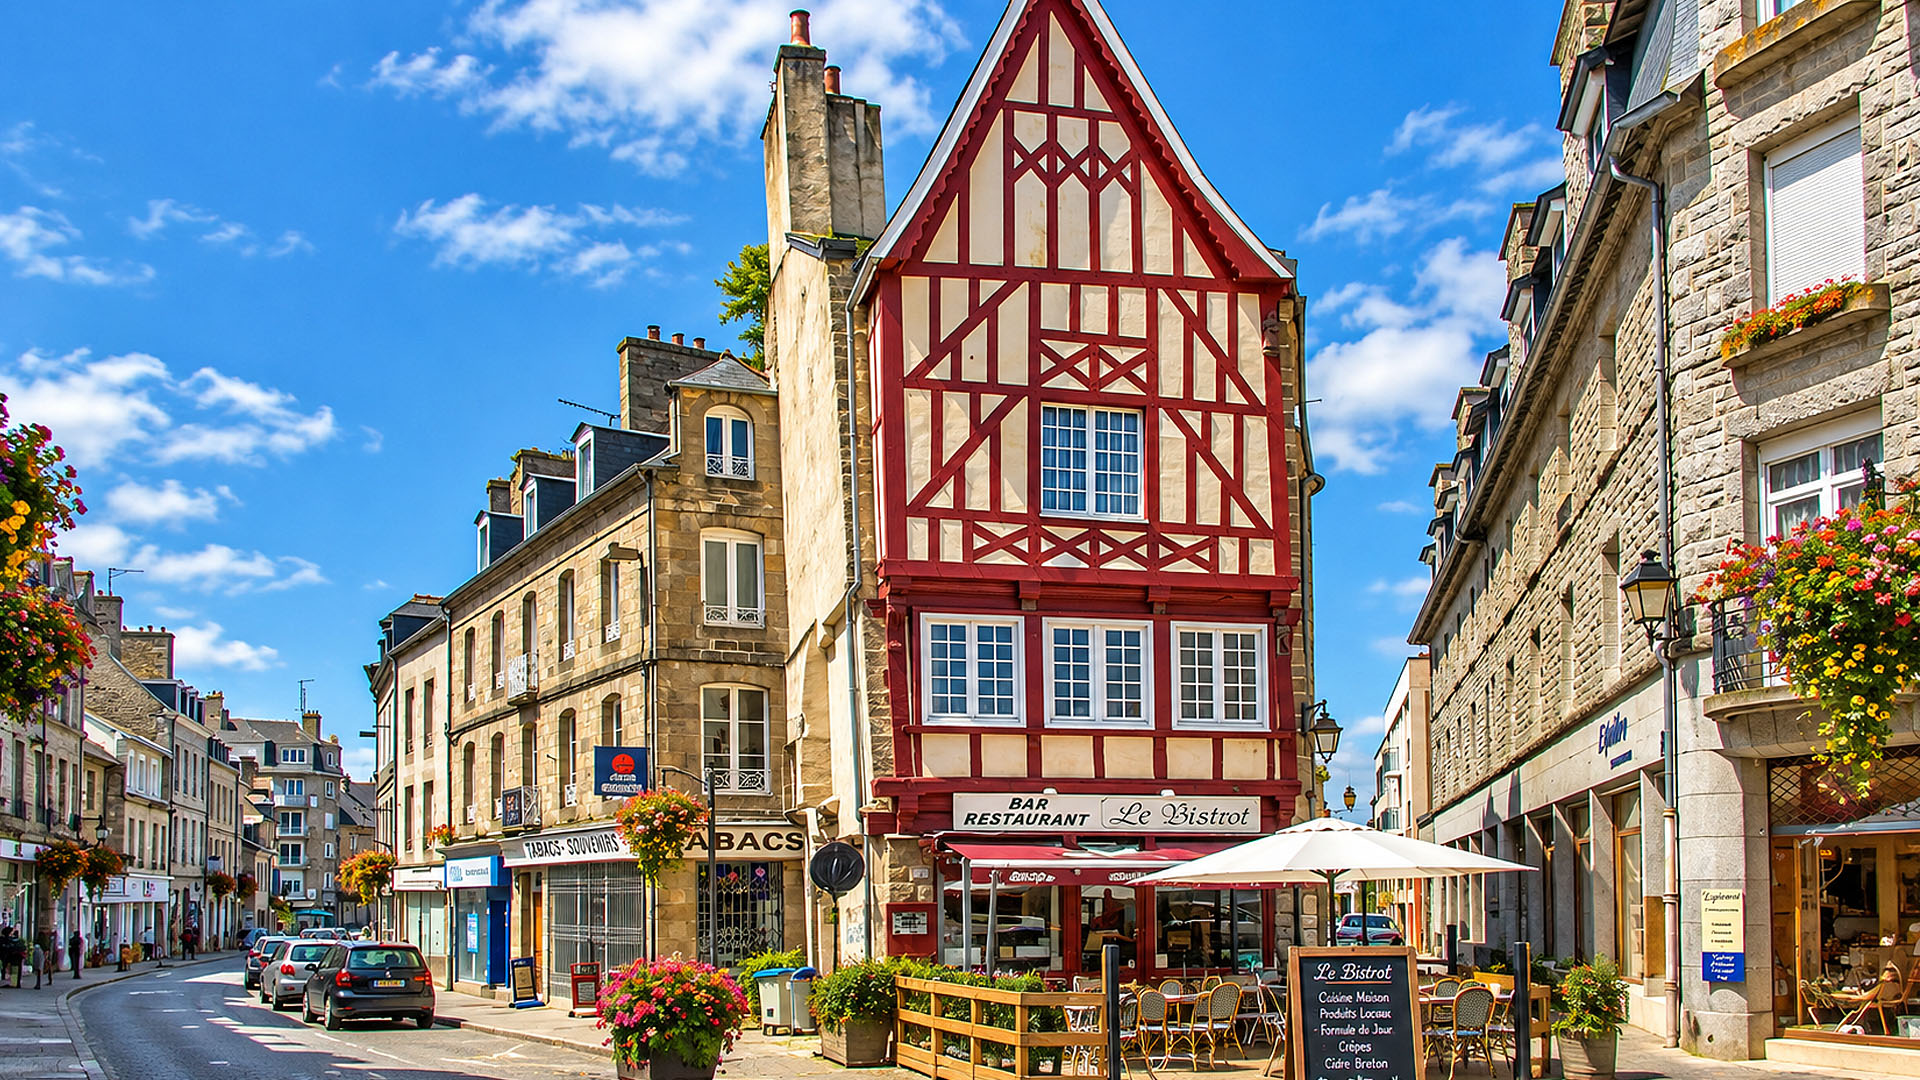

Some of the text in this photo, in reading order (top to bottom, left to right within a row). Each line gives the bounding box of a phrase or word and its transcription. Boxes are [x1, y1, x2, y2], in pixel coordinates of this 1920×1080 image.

[1008, 797, 1050, 811] BAR
[964, 812, 1090, 827] RESTAURANT
[1109, 802, 1250, 826] Le Bistrot
[684, 832, 804, 851] ABACS
[1314, 963, 1392, 981] Le Bistrot
[1356, 991, 1390, 1003] Maison
[1320, 1007, 1357, 1019] Produits
[1324, 1057, 1389, 1070] Cidre Breton
